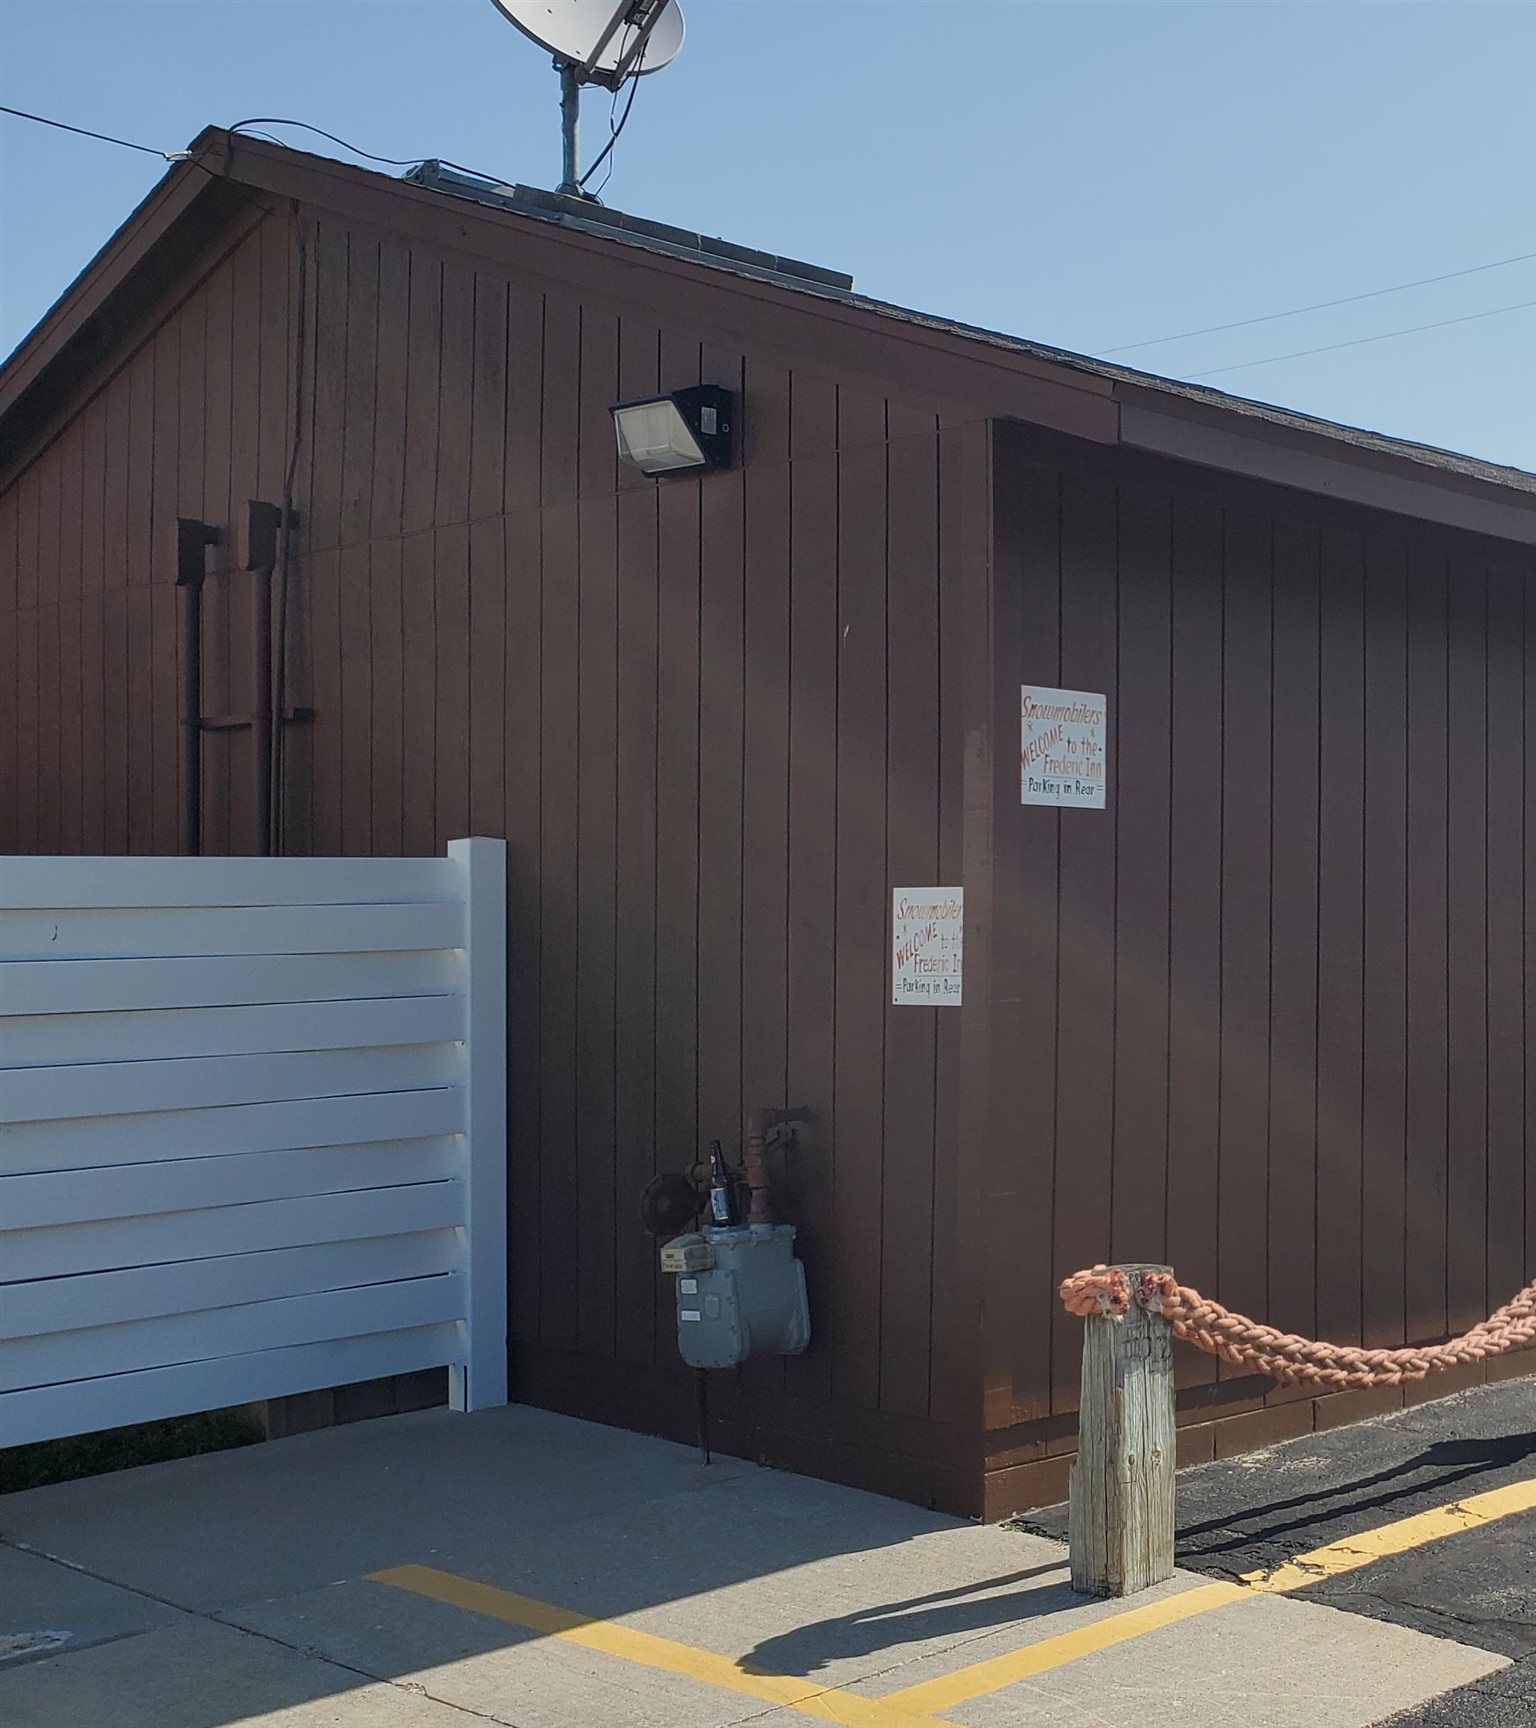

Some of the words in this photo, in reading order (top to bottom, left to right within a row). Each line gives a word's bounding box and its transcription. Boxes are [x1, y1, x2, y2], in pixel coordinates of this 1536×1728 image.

[1021, 695, 1103, 725] Snowmobilers
[1021, 724, 1064, 770] WELCOME
[1066, 736, 1077, 754] to
[1081, 736, 1098, 757] the
[1085, 757, 1102, 777] Inn
[1063, 780, 1072, 795] in
[1075, 780, 1096, 796] Rear
[896, 922, 938, 969] WELCOME
[913, 953, 949, 974] Frederic
[933, 979, 941, 994] in
